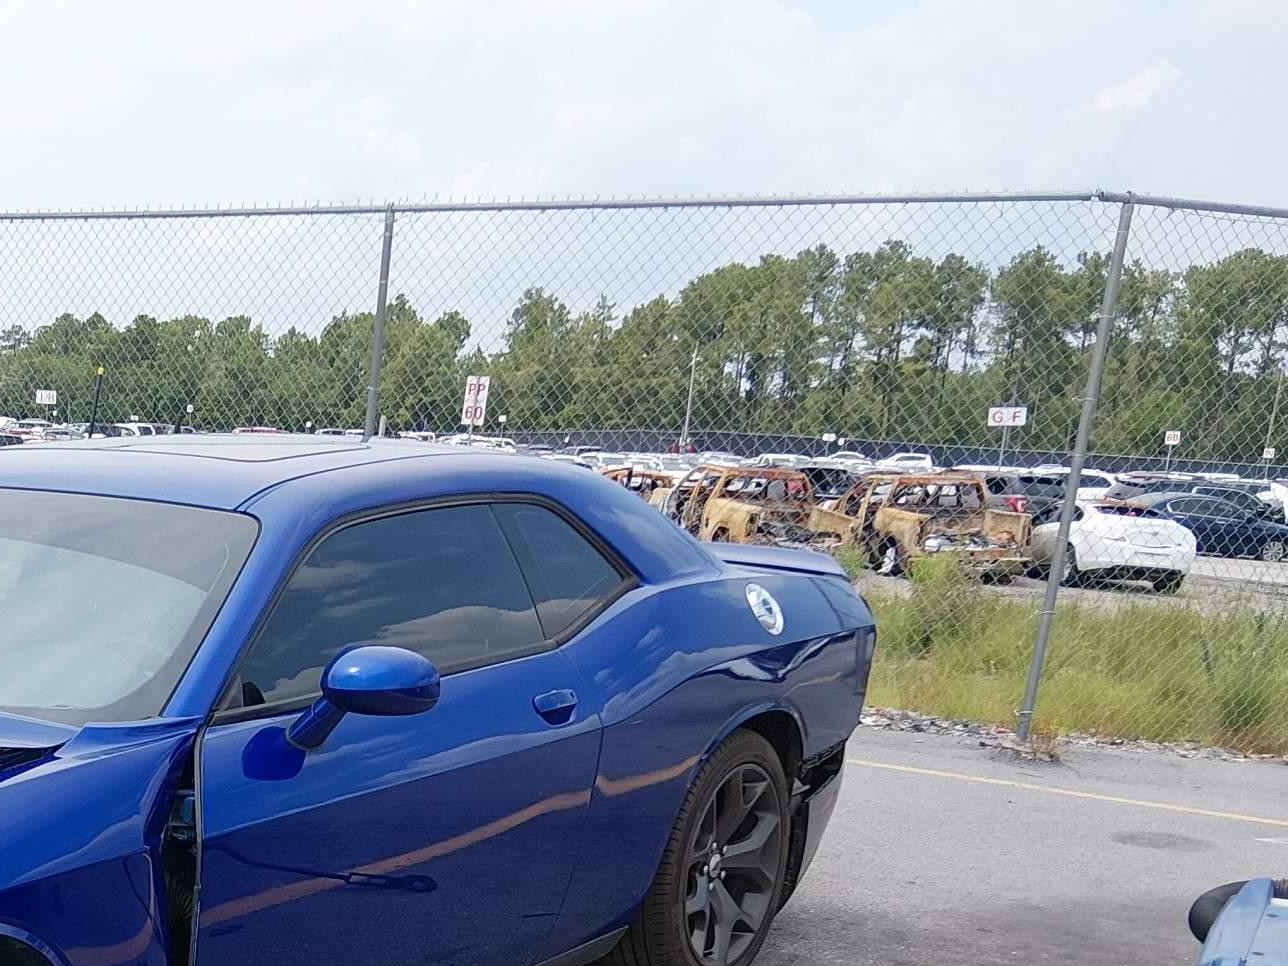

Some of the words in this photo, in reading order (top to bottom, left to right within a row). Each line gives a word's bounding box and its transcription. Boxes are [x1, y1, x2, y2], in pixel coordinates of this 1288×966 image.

[469, 383, 486, 396] PP
[465, 406, 483, 420] 60
[993, 411, 1004, 424] G
[1012, 411, 1021, 423] F
